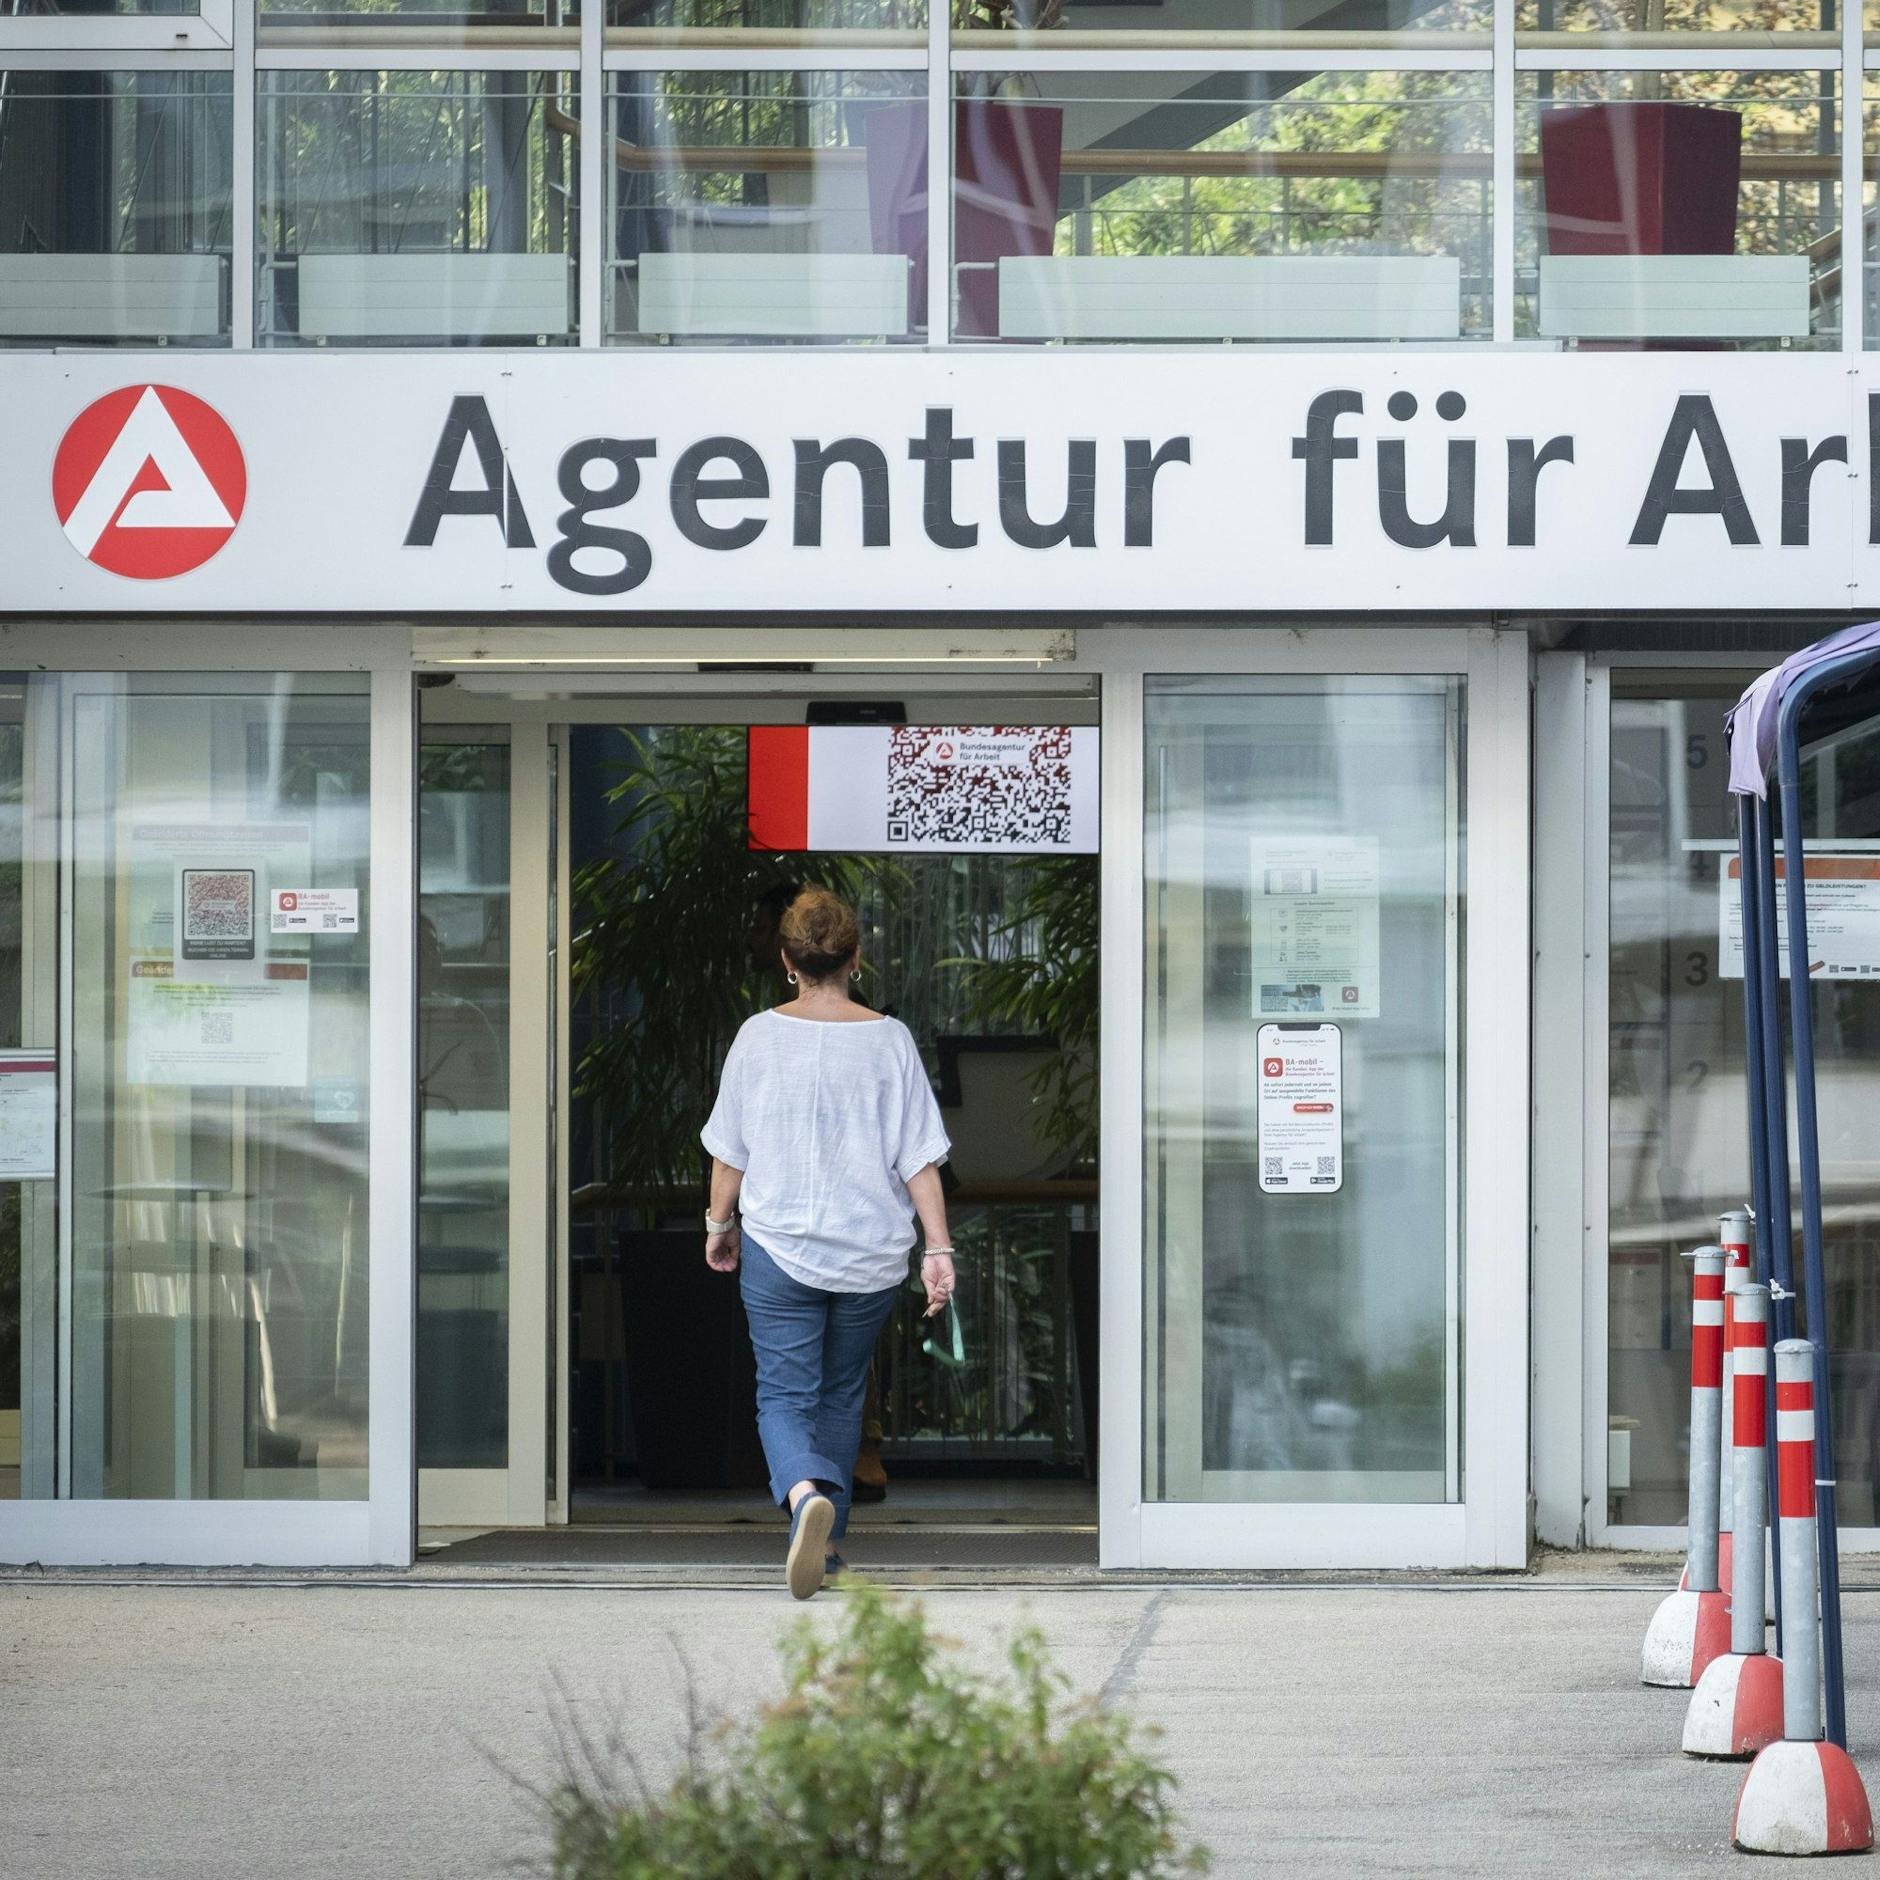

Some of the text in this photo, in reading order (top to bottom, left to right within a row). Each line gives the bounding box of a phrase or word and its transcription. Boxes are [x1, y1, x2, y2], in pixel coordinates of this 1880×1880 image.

[404, 388, 1880, 595] Agentur für Ar
[959, 742, 1026, 752] Bundesagentur
[959, 753, 1001, 761] für Arbeit
[1687, 735, 1708, 769] 5
[1685, 951, 1709, 986] 3
[1285, 1058, 1318, 1066] BA-mobil
